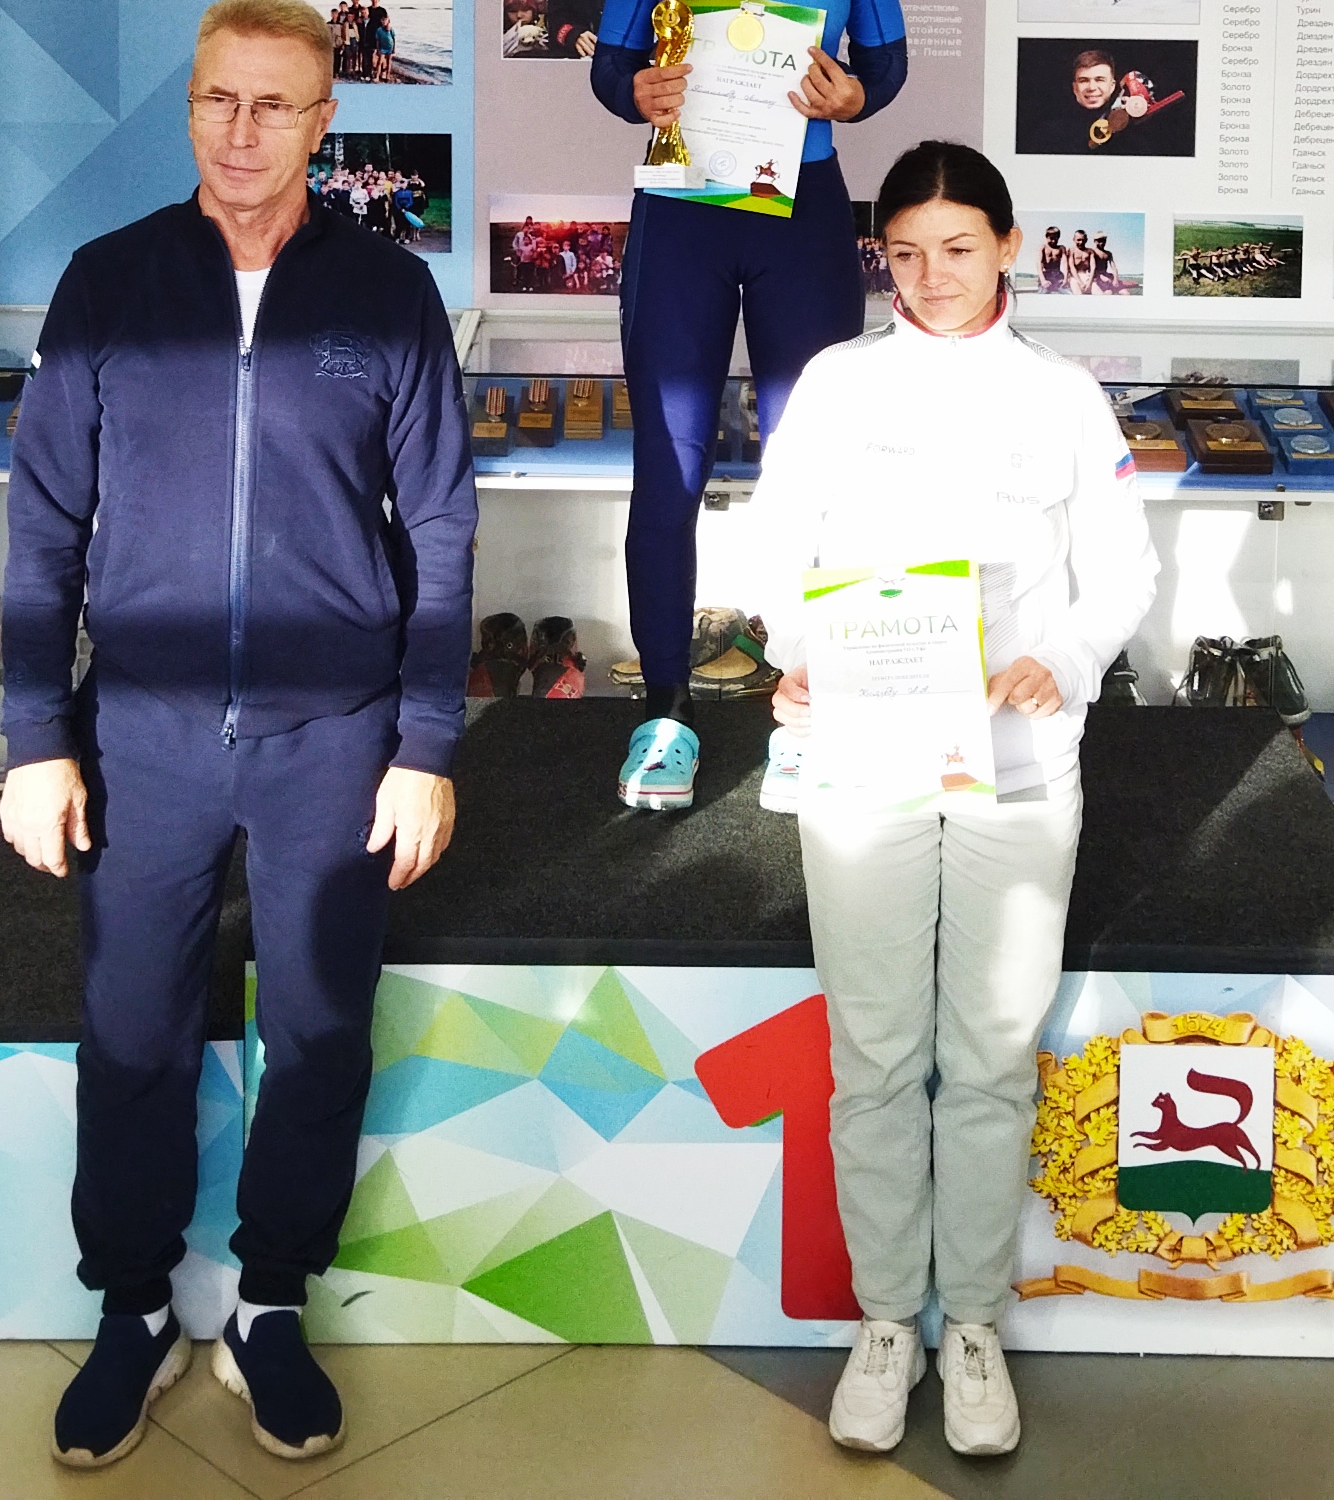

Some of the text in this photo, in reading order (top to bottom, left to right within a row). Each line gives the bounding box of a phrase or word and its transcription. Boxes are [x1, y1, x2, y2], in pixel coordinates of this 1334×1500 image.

[1296, 5, 1322, 17] Турин
[691, 37, 796, 71] ГРМОТА
[1218, 185, 1249, 196] Бронза
[1291, 186, 1326, 197] Гданьск
[829, 615, 958, 640] ГРАМОТА
[869, 656, 924, 666] НАГРАЖДАЕТ
[1172, 1013, 1226, 1037] 1574
